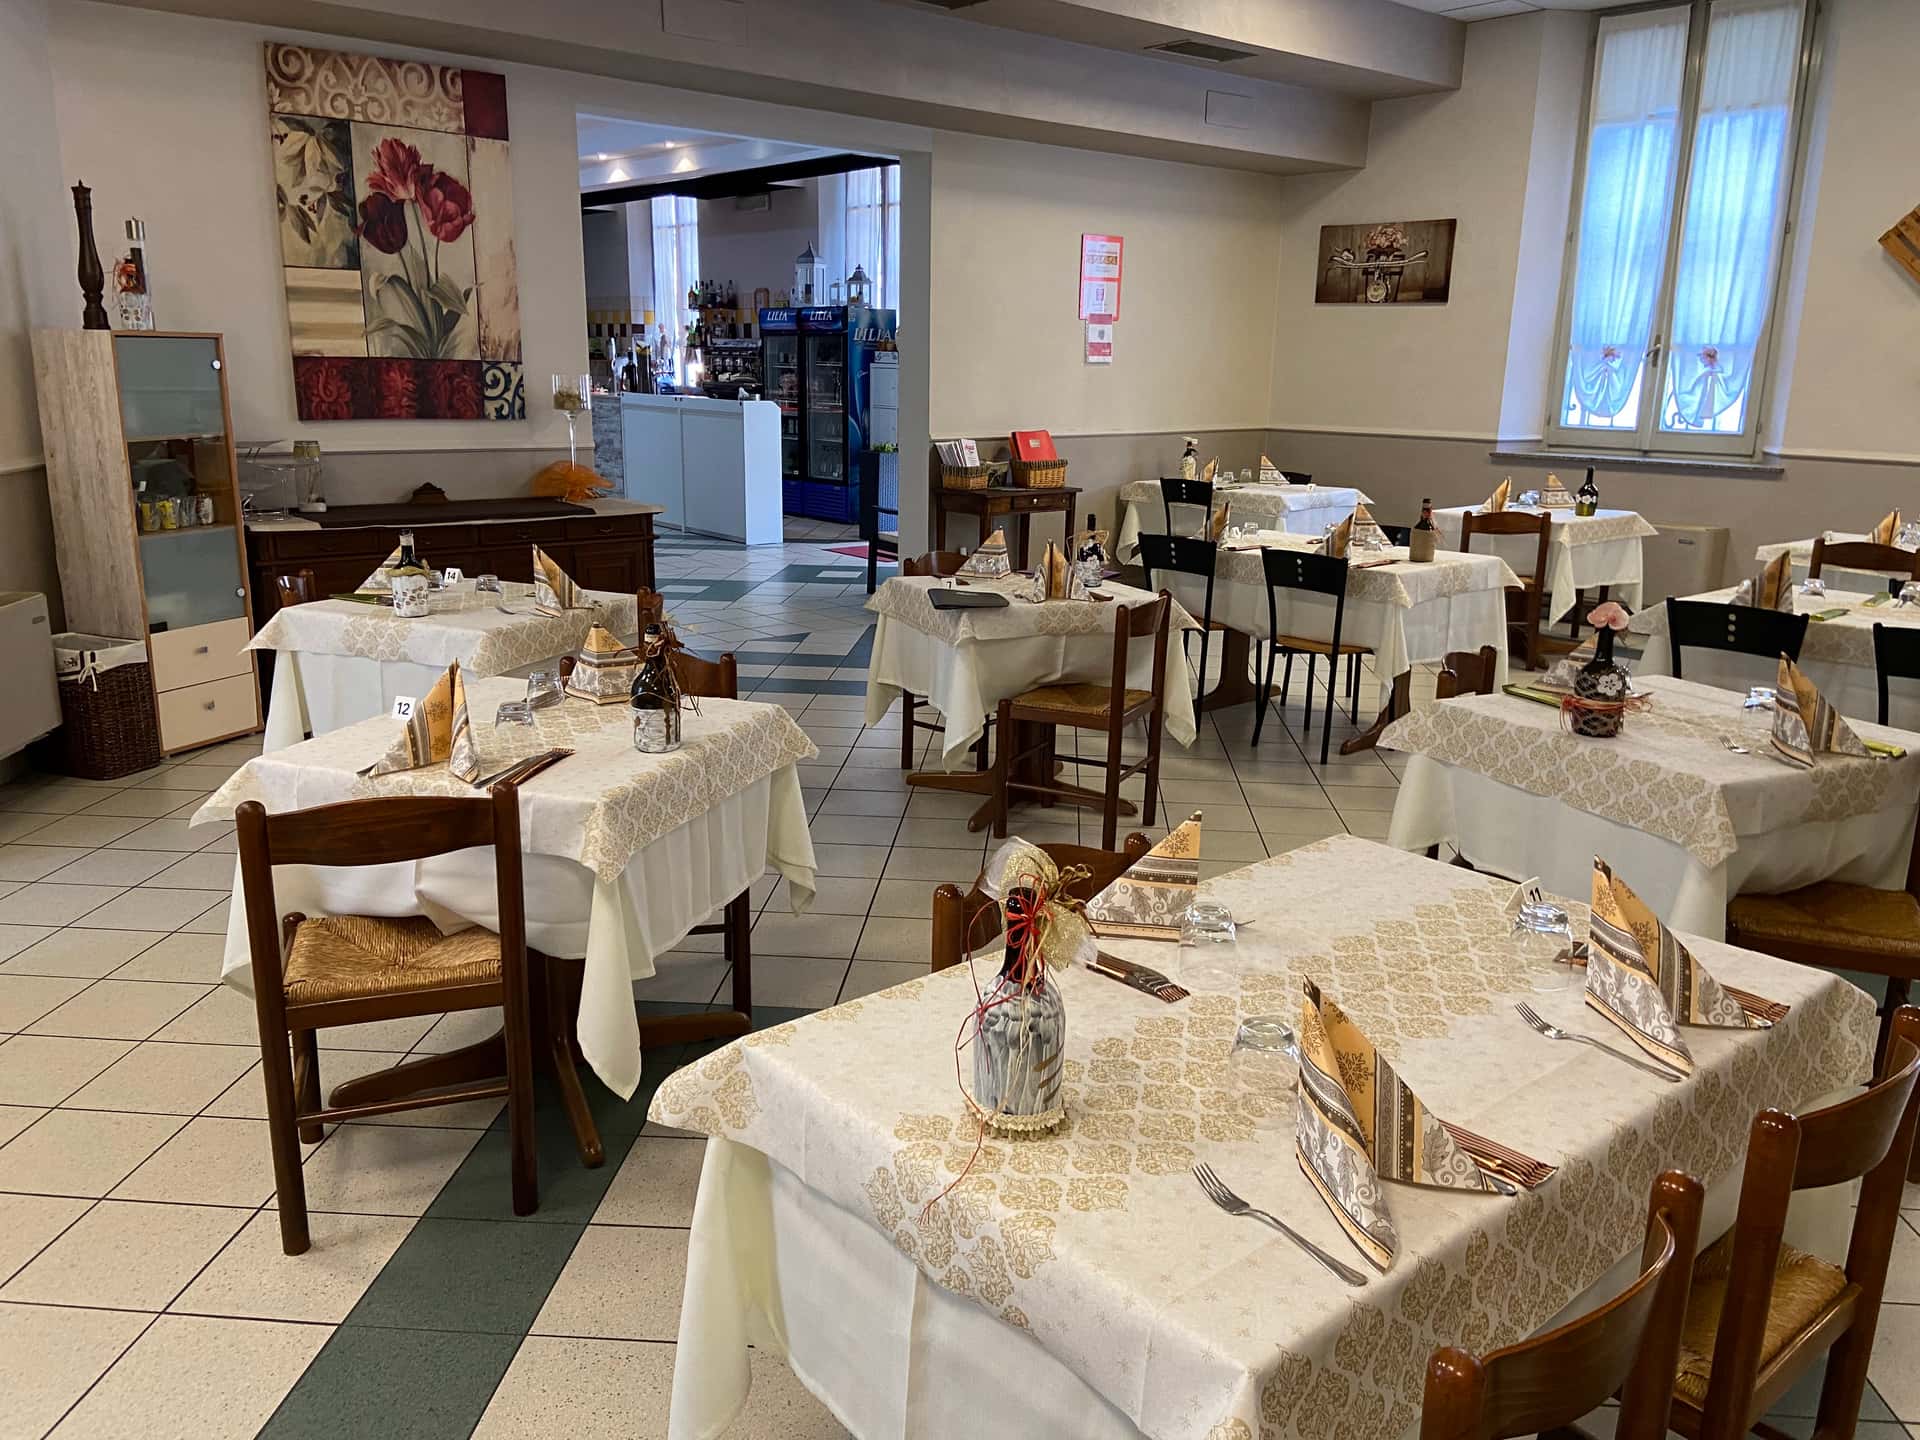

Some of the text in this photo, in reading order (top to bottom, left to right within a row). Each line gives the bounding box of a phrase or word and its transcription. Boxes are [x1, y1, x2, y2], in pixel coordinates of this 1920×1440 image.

[809, 310, 833, 321] LILIA
[853, 328, 892, 342] LILIA
[447, 571, 456, 580] 14
[397, 702, 410, 716] 12
[1529, 886, 1542, 902] 11
